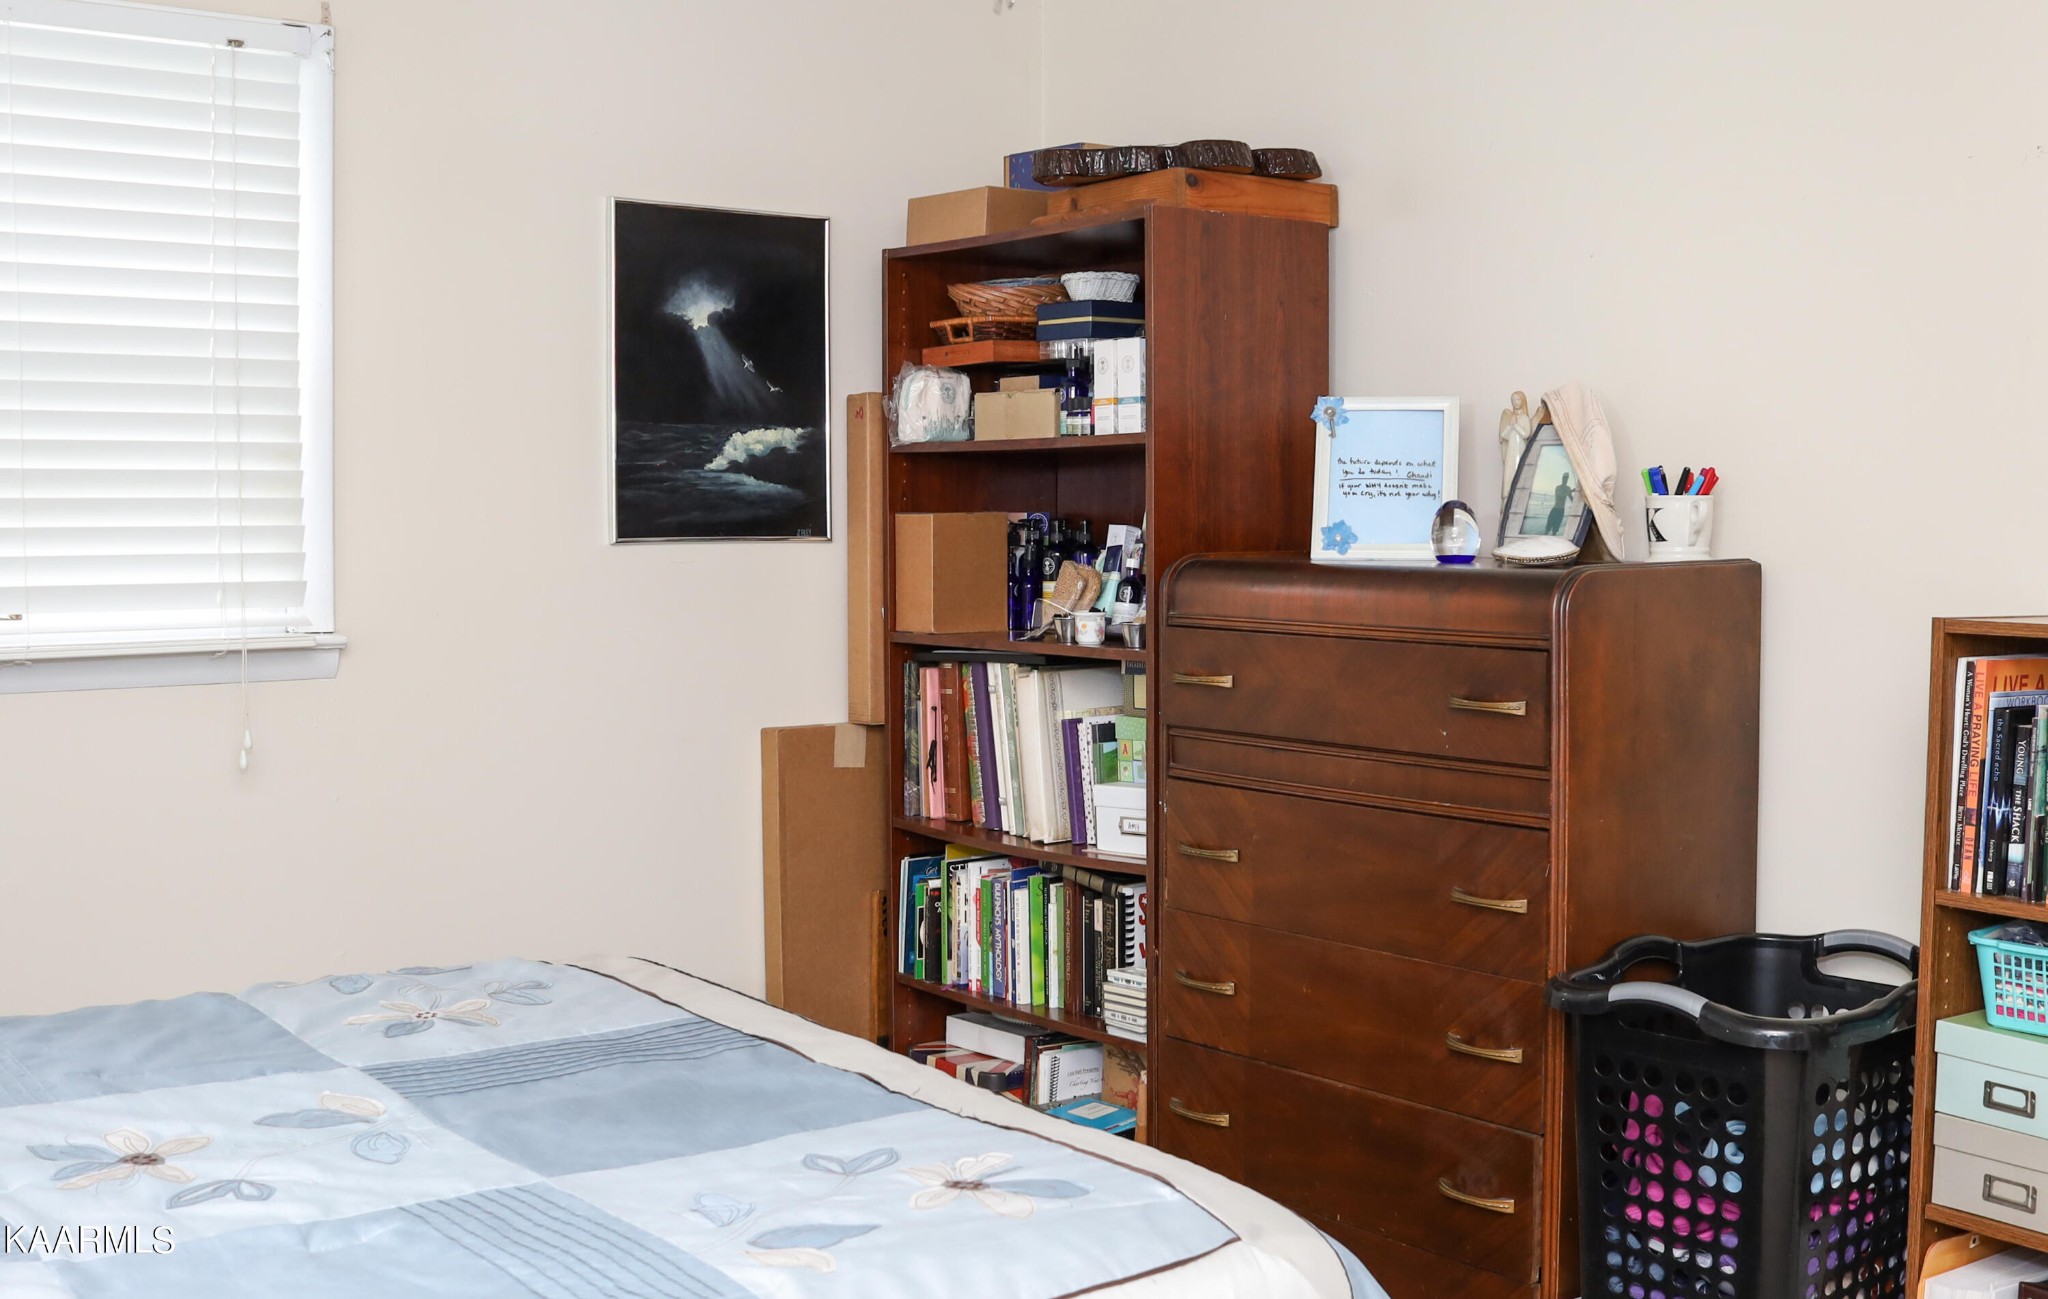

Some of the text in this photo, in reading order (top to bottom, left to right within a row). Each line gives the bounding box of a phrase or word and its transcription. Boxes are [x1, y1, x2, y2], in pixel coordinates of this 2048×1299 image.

[1342, 468, 1355, 477] you
[1358, 467, 1366, 475] do
[1349, 457, 1371, 465] future
[1417, 459, 1436, 467] what
[1342, 490, 1358, 499] you
[1405, 491, 1420, 500] your
[1347, 483, 1362, 491] your
[1646, 508, 1669, 543] K
[1964, 679, 1973, 707] Woman's
[1962, 729, 1970, 749] God's
[1968, 672, 1985, 797] LIVE A PRAYING LIFE
[1122, 743, 1129, 755] A
[1993, 719, 2004, 782] the Sacred echo
[2016, 740, 2027, 775] YOUNG
[1959, 750, 1968, 778] Dwelling
[1958, 778, 1966, 797] Place
[2010, 789, 2023, 843] THE SHACK
[1964, 837, 1974, 861] DEAN
[1987, 839, 1995, 863] feinberg
[994, 882, 1003, 983] BULFINCH'S MYTHOLOGY
